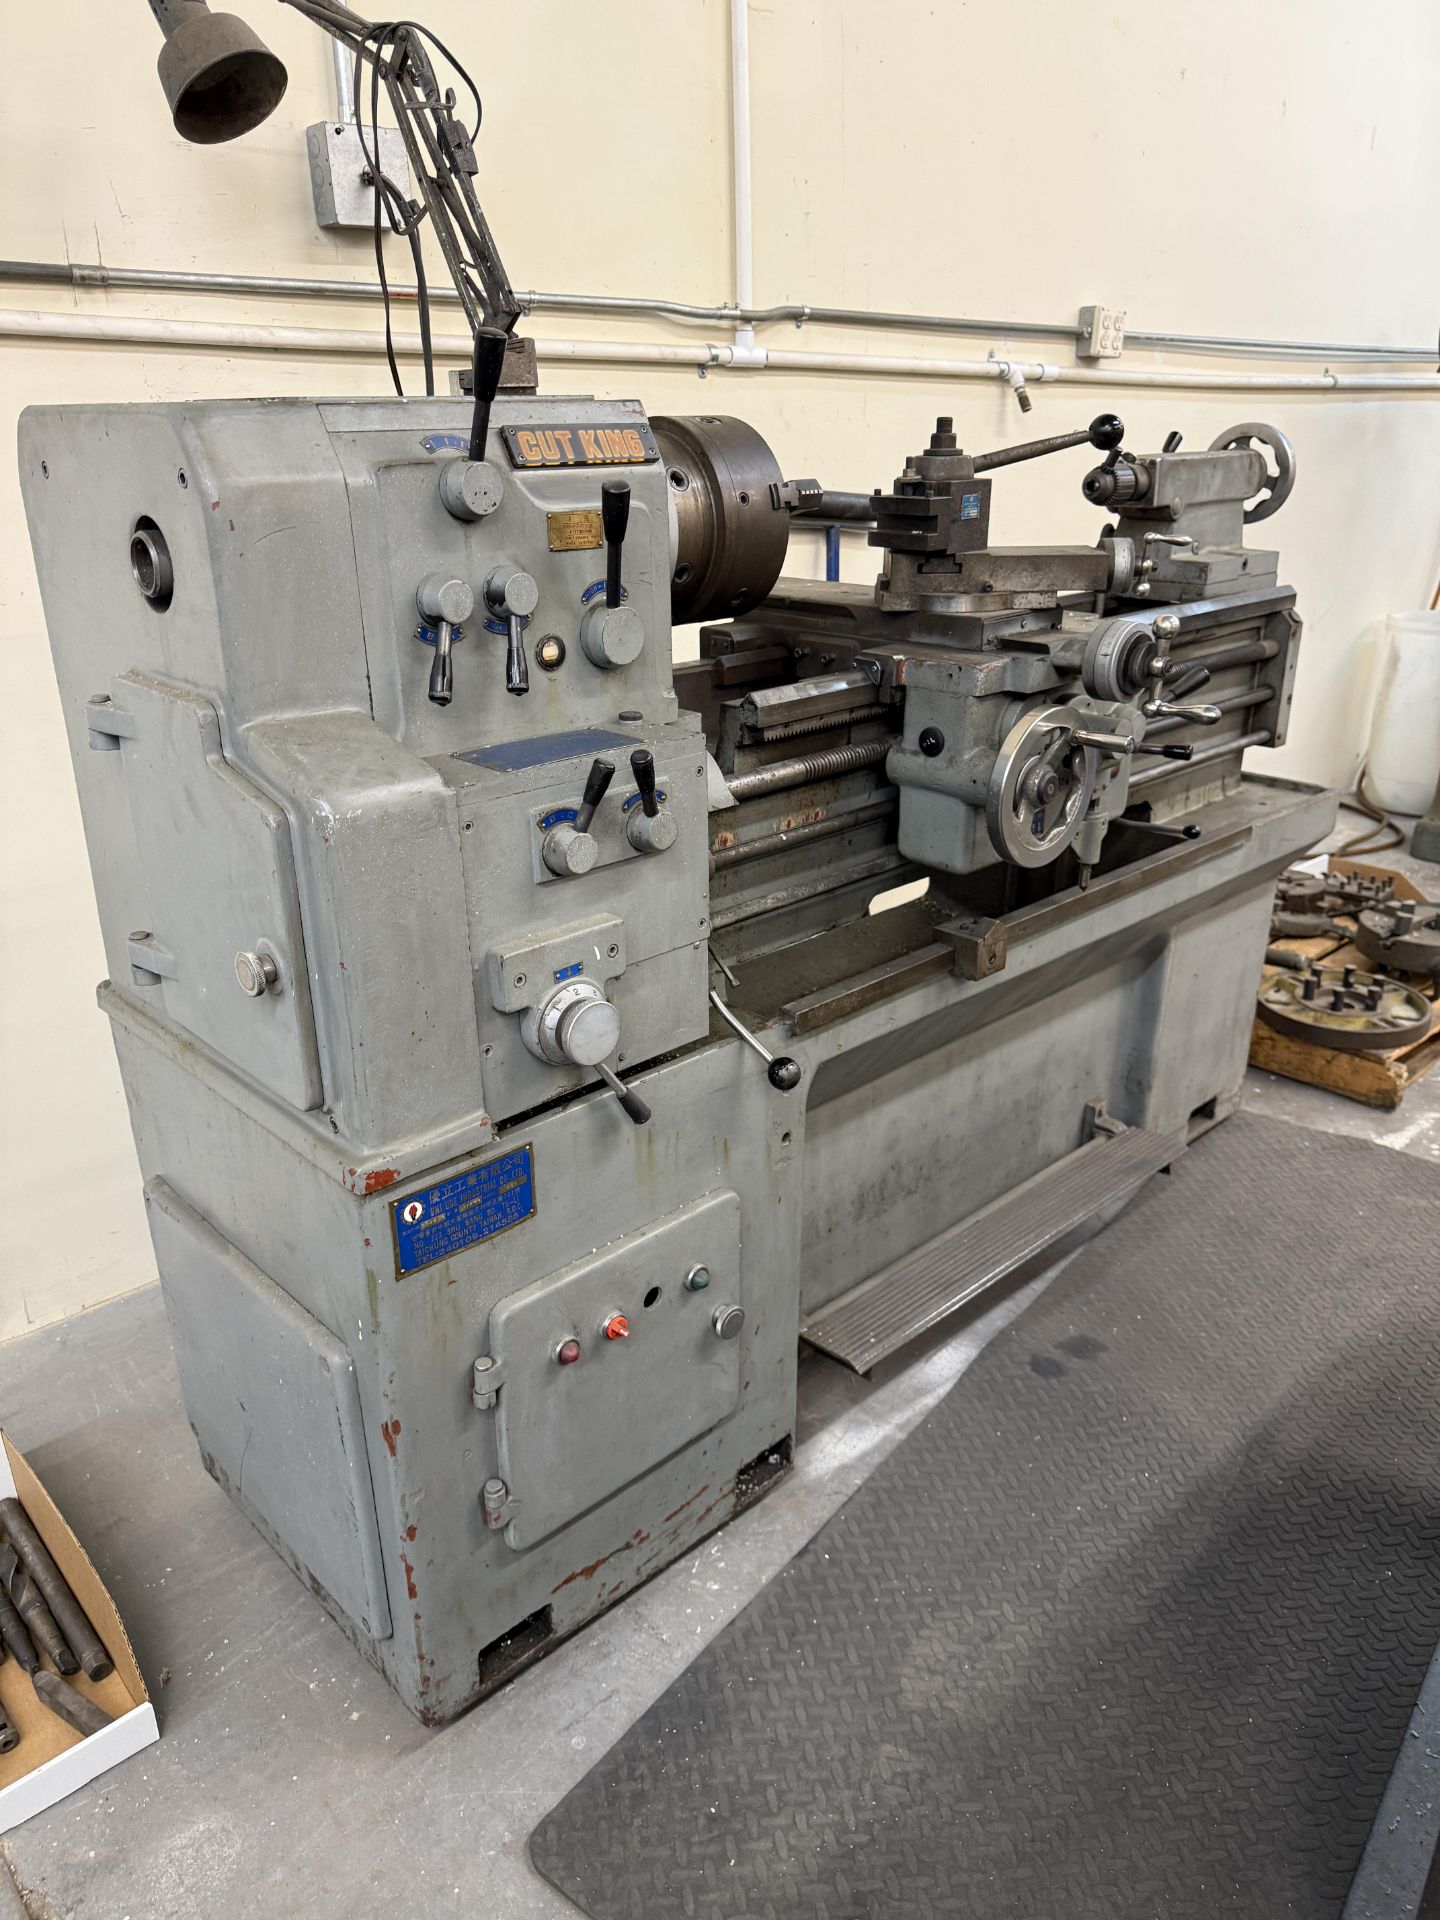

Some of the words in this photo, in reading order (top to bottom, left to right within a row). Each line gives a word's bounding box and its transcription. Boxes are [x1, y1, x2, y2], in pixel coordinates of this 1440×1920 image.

[517, 431, 574, 461] CUT
[578, 429, 645, 459] KING
[460, 1180, 497, 1203] INDUSTRIAL
[450, 1223, 476, 1242] COUNTY
